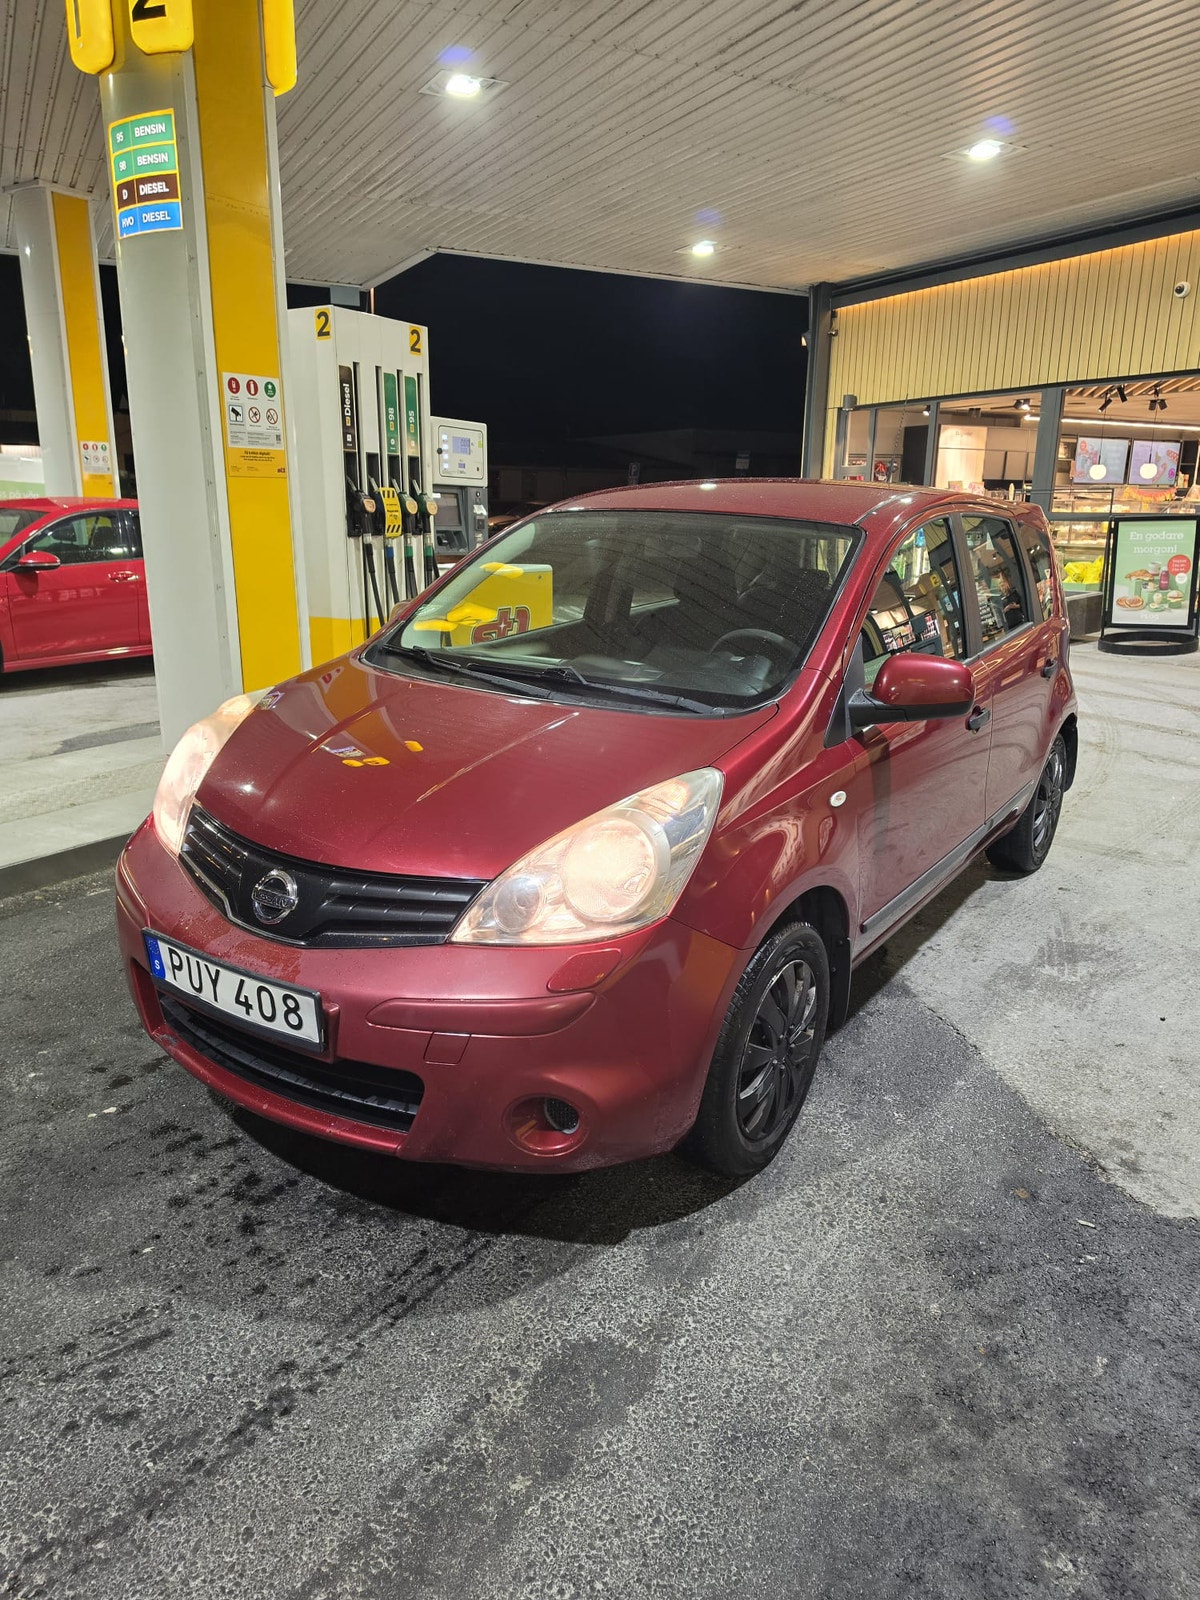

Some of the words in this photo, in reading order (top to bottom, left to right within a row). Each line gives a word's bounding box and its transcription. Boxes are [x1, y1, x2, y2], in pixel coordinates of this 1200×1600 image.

[116, 132, 124, 143] 95
[134, 123, 166, 137] BENSIN
[119, 160, 127, 171] 98
[137, 152, 168, 166] BENSIN
[122, 189, 128, 200] D
[139, 181, 170, 196] DIESEL
[122, 216, 134, 228] HVO
[142, 211, 171, 223] DIESEL
[317, 311, 330, 337] 2
[410, 329, 421, 353] 2
[343, 383, 352, 416] Diesel
[388, 407, 395, 421] 98
[408, 410, 415, 423] 95
[1129, 531, 1143, 540] En
[1145, 531, 1184, 542] godare
[1133, 544, 1178, 555] morgon!
[154, 960, 160, 970] S
[167, 947, 220, 1003] PUY
[234, 978, 303, 1031] 408
